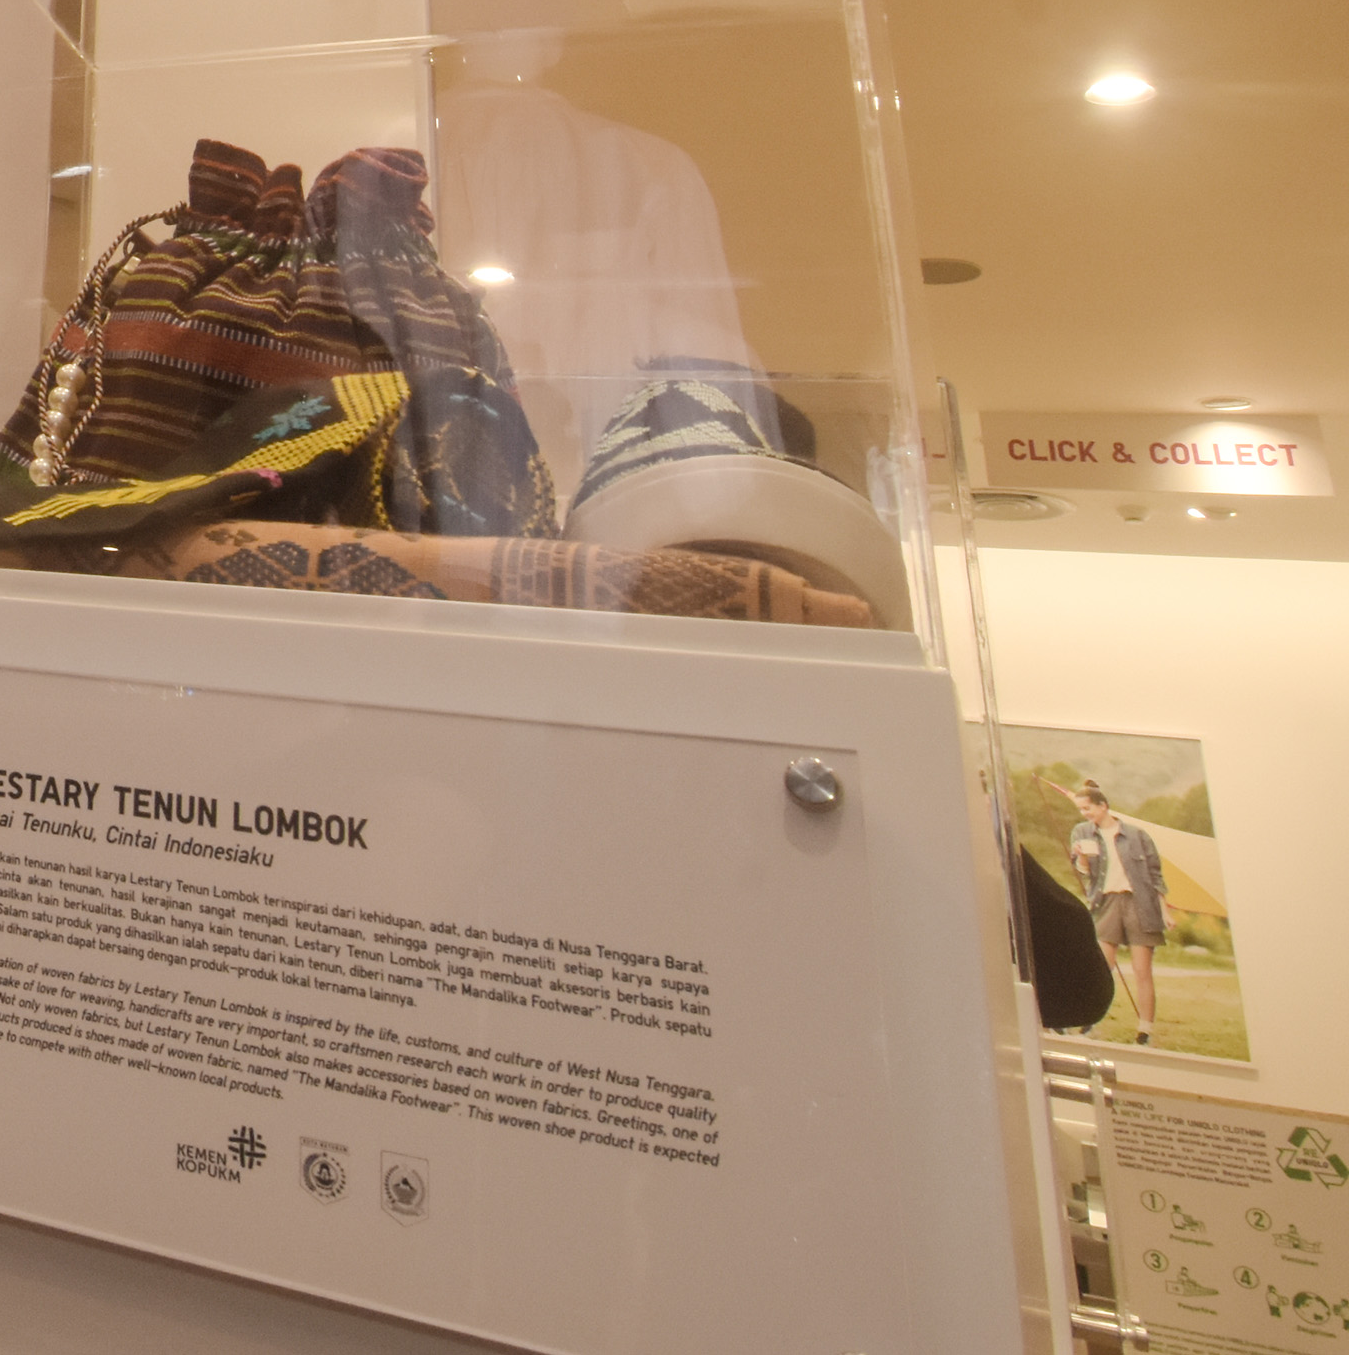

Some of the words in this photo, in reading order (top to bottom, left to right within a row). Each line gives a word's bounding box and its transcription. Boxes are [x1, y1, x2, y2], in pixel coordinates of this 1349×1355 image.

[1008, 439, 1098, 463] CLICK
[1112, 442, 1135, 464] &
[1149, 442, 1298, 467] COLLECT
[113, 785, 217, 828] TENUN
[232, 801, 368, 849] LOMBOK
[21, 813, 98, 844] Tenunku,
[105, 825, 158, 850] Cintai
[164, 832, 274, 868] Indonesiaku
[0, 851, 21, 865] kain
[24, 855, 66, 873] tenunan
[68, 862, 93, 877] hasil
[95, 866, 127, 884] karya
[129, 872, 173, 893] Lestary
[175, 878, 210, 897] Tenun
[212, 885, 260, 904] Lombok
[263, 893, 328, 915] terinspirasi
[331, 904, 356, 919] dari
[464, 925, 488, 940] dan
[492, 928, 539, 950] budaya
[542, 937, 555, 951] di
[558, 938, 592, 957] Nusa
[595, 944, 661, 968] Tenggara
[27, 874, 53, 888] akan
[111, 887, 135, 902] hasil
[142, 892, 192, 912] kerajinan
[199, 904, 236, 920] sangat
[243, 911, 288, 928] menjadi
[374, 932, 427, 952] sehingga
[435, 942, 494, 963] pengrajin
[502, 953, 555, 971] meneliti
[564, 961, 603, 982] setiap
[612, 967, 652, 988] karya
[661, 978, 710, 998] supaya
[37, 892, 59, 907] kain
[130, 908, 166, 925] Bukan
[170, 915, 204, 934] hanya
[209, 921, 233, 937] kain
[294, 935, 341, 958] Lestary
[346, 944, 384, 963] Tenun
[389, 951, 441, 972] Lombok
[447, 964, 474, 979] juga
[480, 970, 542, 989] membuat
[549, 978, 611, 1000] aksesoris
[617, 988, 674, 1011] berbasis
[680, 998, 711, 1017] kain
[32, 911, 53, 924] satu
[55, 916, 92, 931] produk
[96, 923, 121, 939] yang
[124, 926, 179, 946] dihasilkan
[182, 936, 209, 950] ialah
[212, 943, 250, 959] sepatu
[253, 948, 276, 962] dari
[279, 952, 304, 968] kain
[349, 964, 384, 981] diberi
[387, 973, 424, 989] nama
[461, 982, 528, 1007] Mandalika
[610, 1007, 661, 1030] Produk
[665, 1020, 713, 1038] sepatu
[1167, 1116, 1184, 1126] FOR
[1187, 1119, 1219, 1131] UNIQLO
[1222, 1125, 1266, 1138] CLOTHING
[177, 1143, 227, 1166] KEMEN
[177, 1156, 241, 1184] KOPUKM
[1253, 1211, 1266, 1228] 2
[1150, 1253, 1162, 1269] 3
[1240, 1269, 1252, 1285] 4
